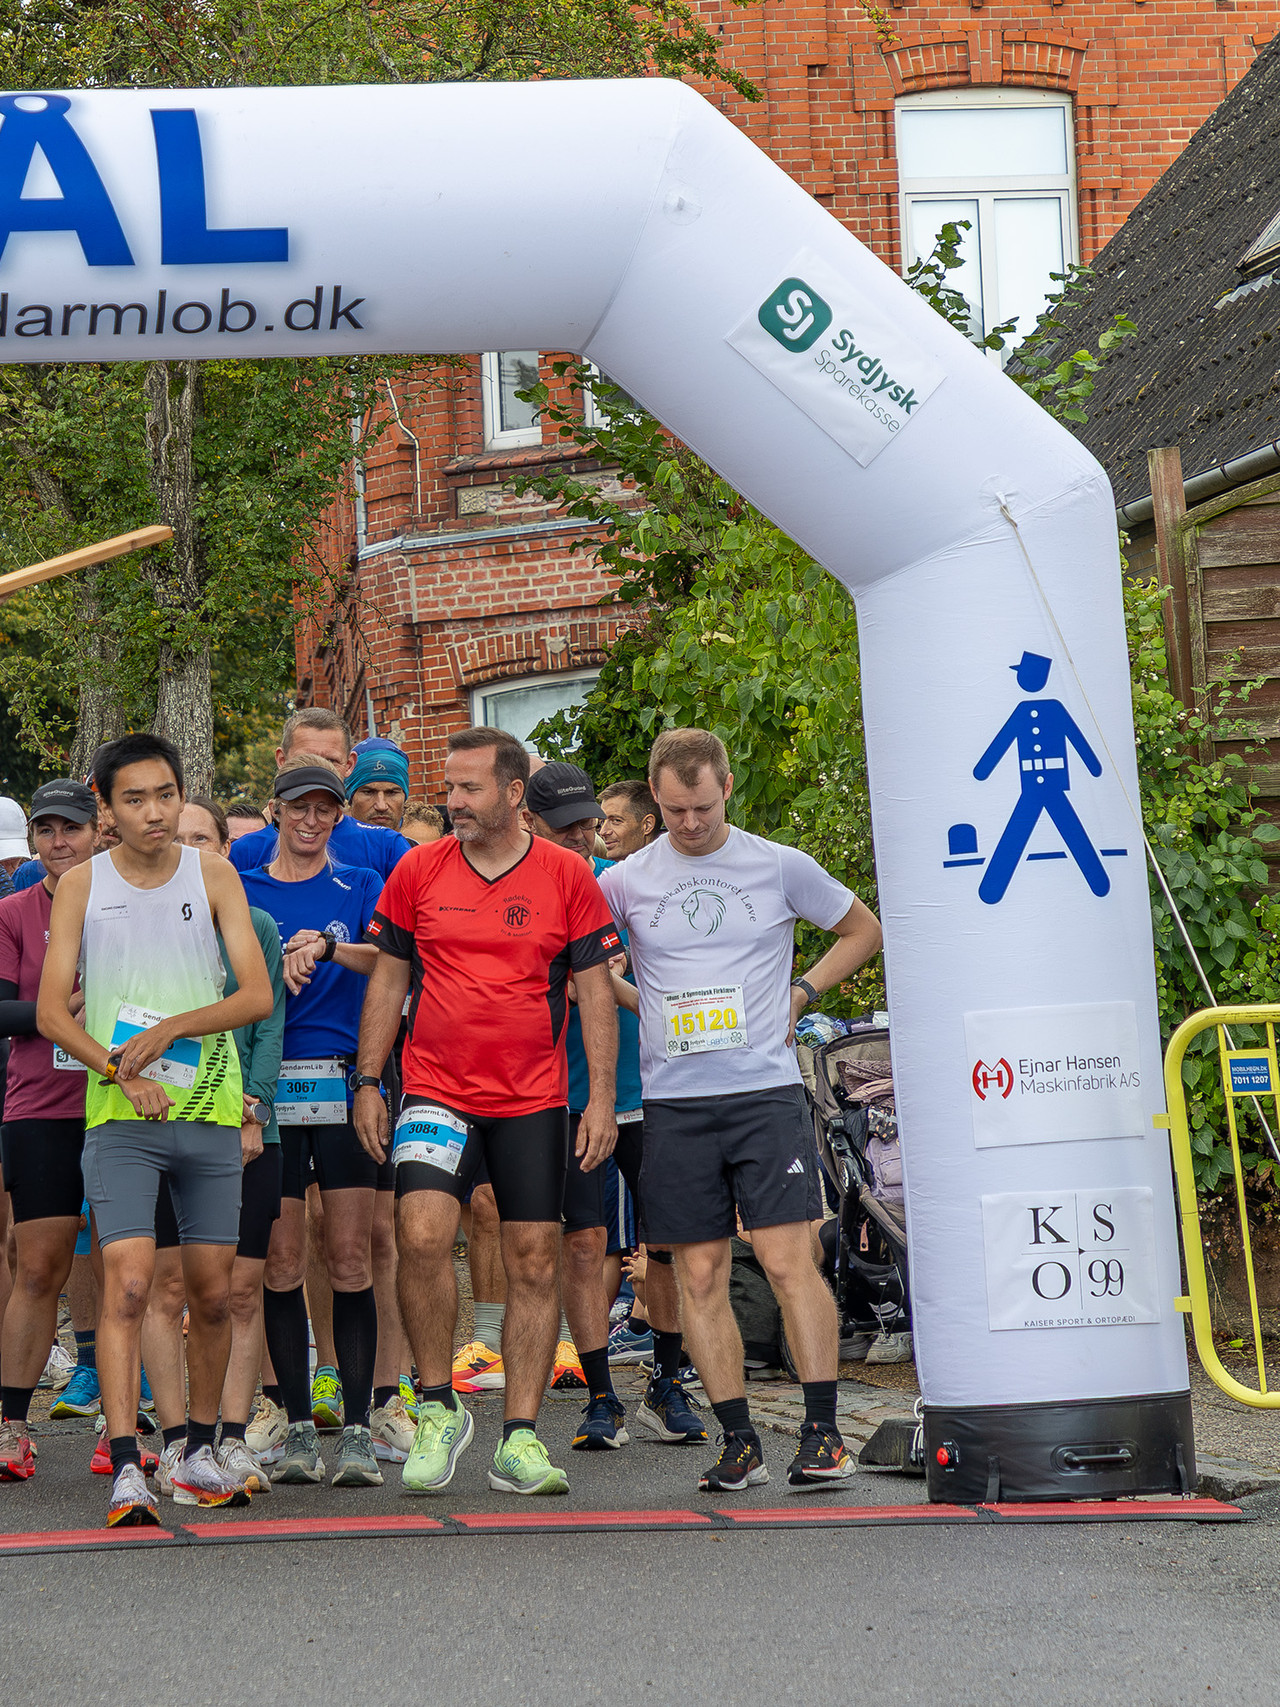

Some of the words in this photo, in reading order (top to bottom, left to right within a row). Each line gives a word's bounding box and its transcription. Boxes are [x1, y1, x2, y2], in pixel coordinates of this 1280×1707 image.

[814, 349, 900, 432] Sparekasse
[649, 876, 743, 928] Regnskabskontoret
[741, 894, 757, 922] Løve
[670, 1007, 739, 1037] 15120
[1018, 1058, 1062, 1077] Ejnar
[1066, 1055, 1121, 1071] Hansen
[286, 1081, 317, 1094] 3067
[1020, 1073, 1118, 1095] Maskinfabrik
[1119, 1071, 1141, 1088] A/S
[1233, 1076, 1250, 1085] 7011
[1251, 1075, 1269, 1084] 1207
[408, 1123, 439, 1136] 3084
[1027, 1206, 1071, 1245] K
[1093, 1203, 1115, 1242] S
[1032, 1261, 1072, 1300] O
[1088, 1258, 1124, 1297] 99
[1024, 1319, 1054, 1328] KAISER
[1056, 1317, 1084, 1326] SPORT
[1087, 1317, 1092, 1325] &
[1095, 1315, 1136, 1324] ORTOPÆDI
